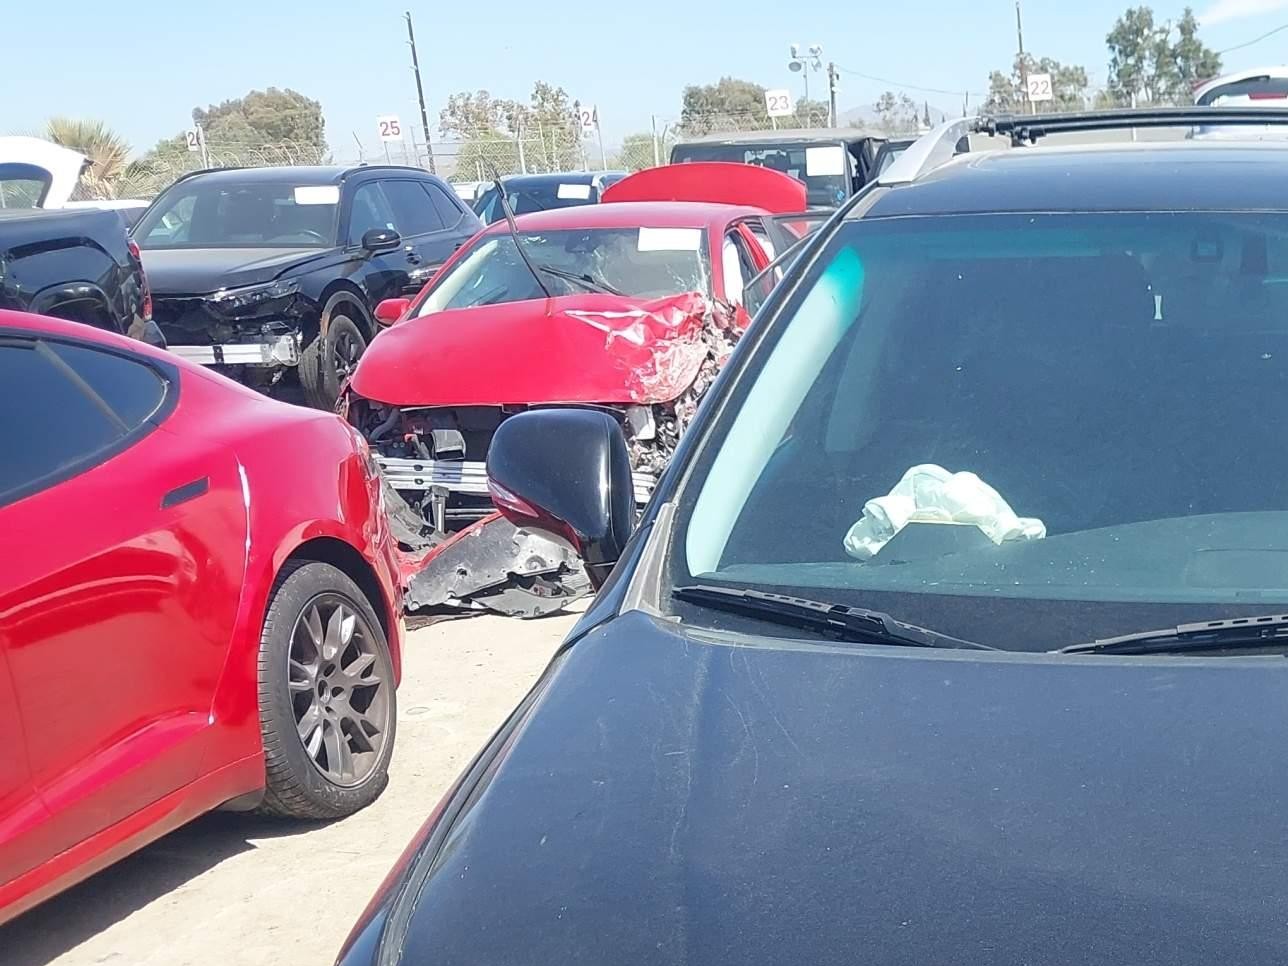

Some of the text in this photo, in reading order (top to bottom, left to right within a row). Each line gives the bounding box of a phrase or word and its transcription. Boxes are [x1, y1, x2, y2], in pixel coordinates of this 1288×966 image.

[1030, 80, 1050, 95] 22
[769, 95, 789, 111] 23
[379, 120, 401, 137] 25
